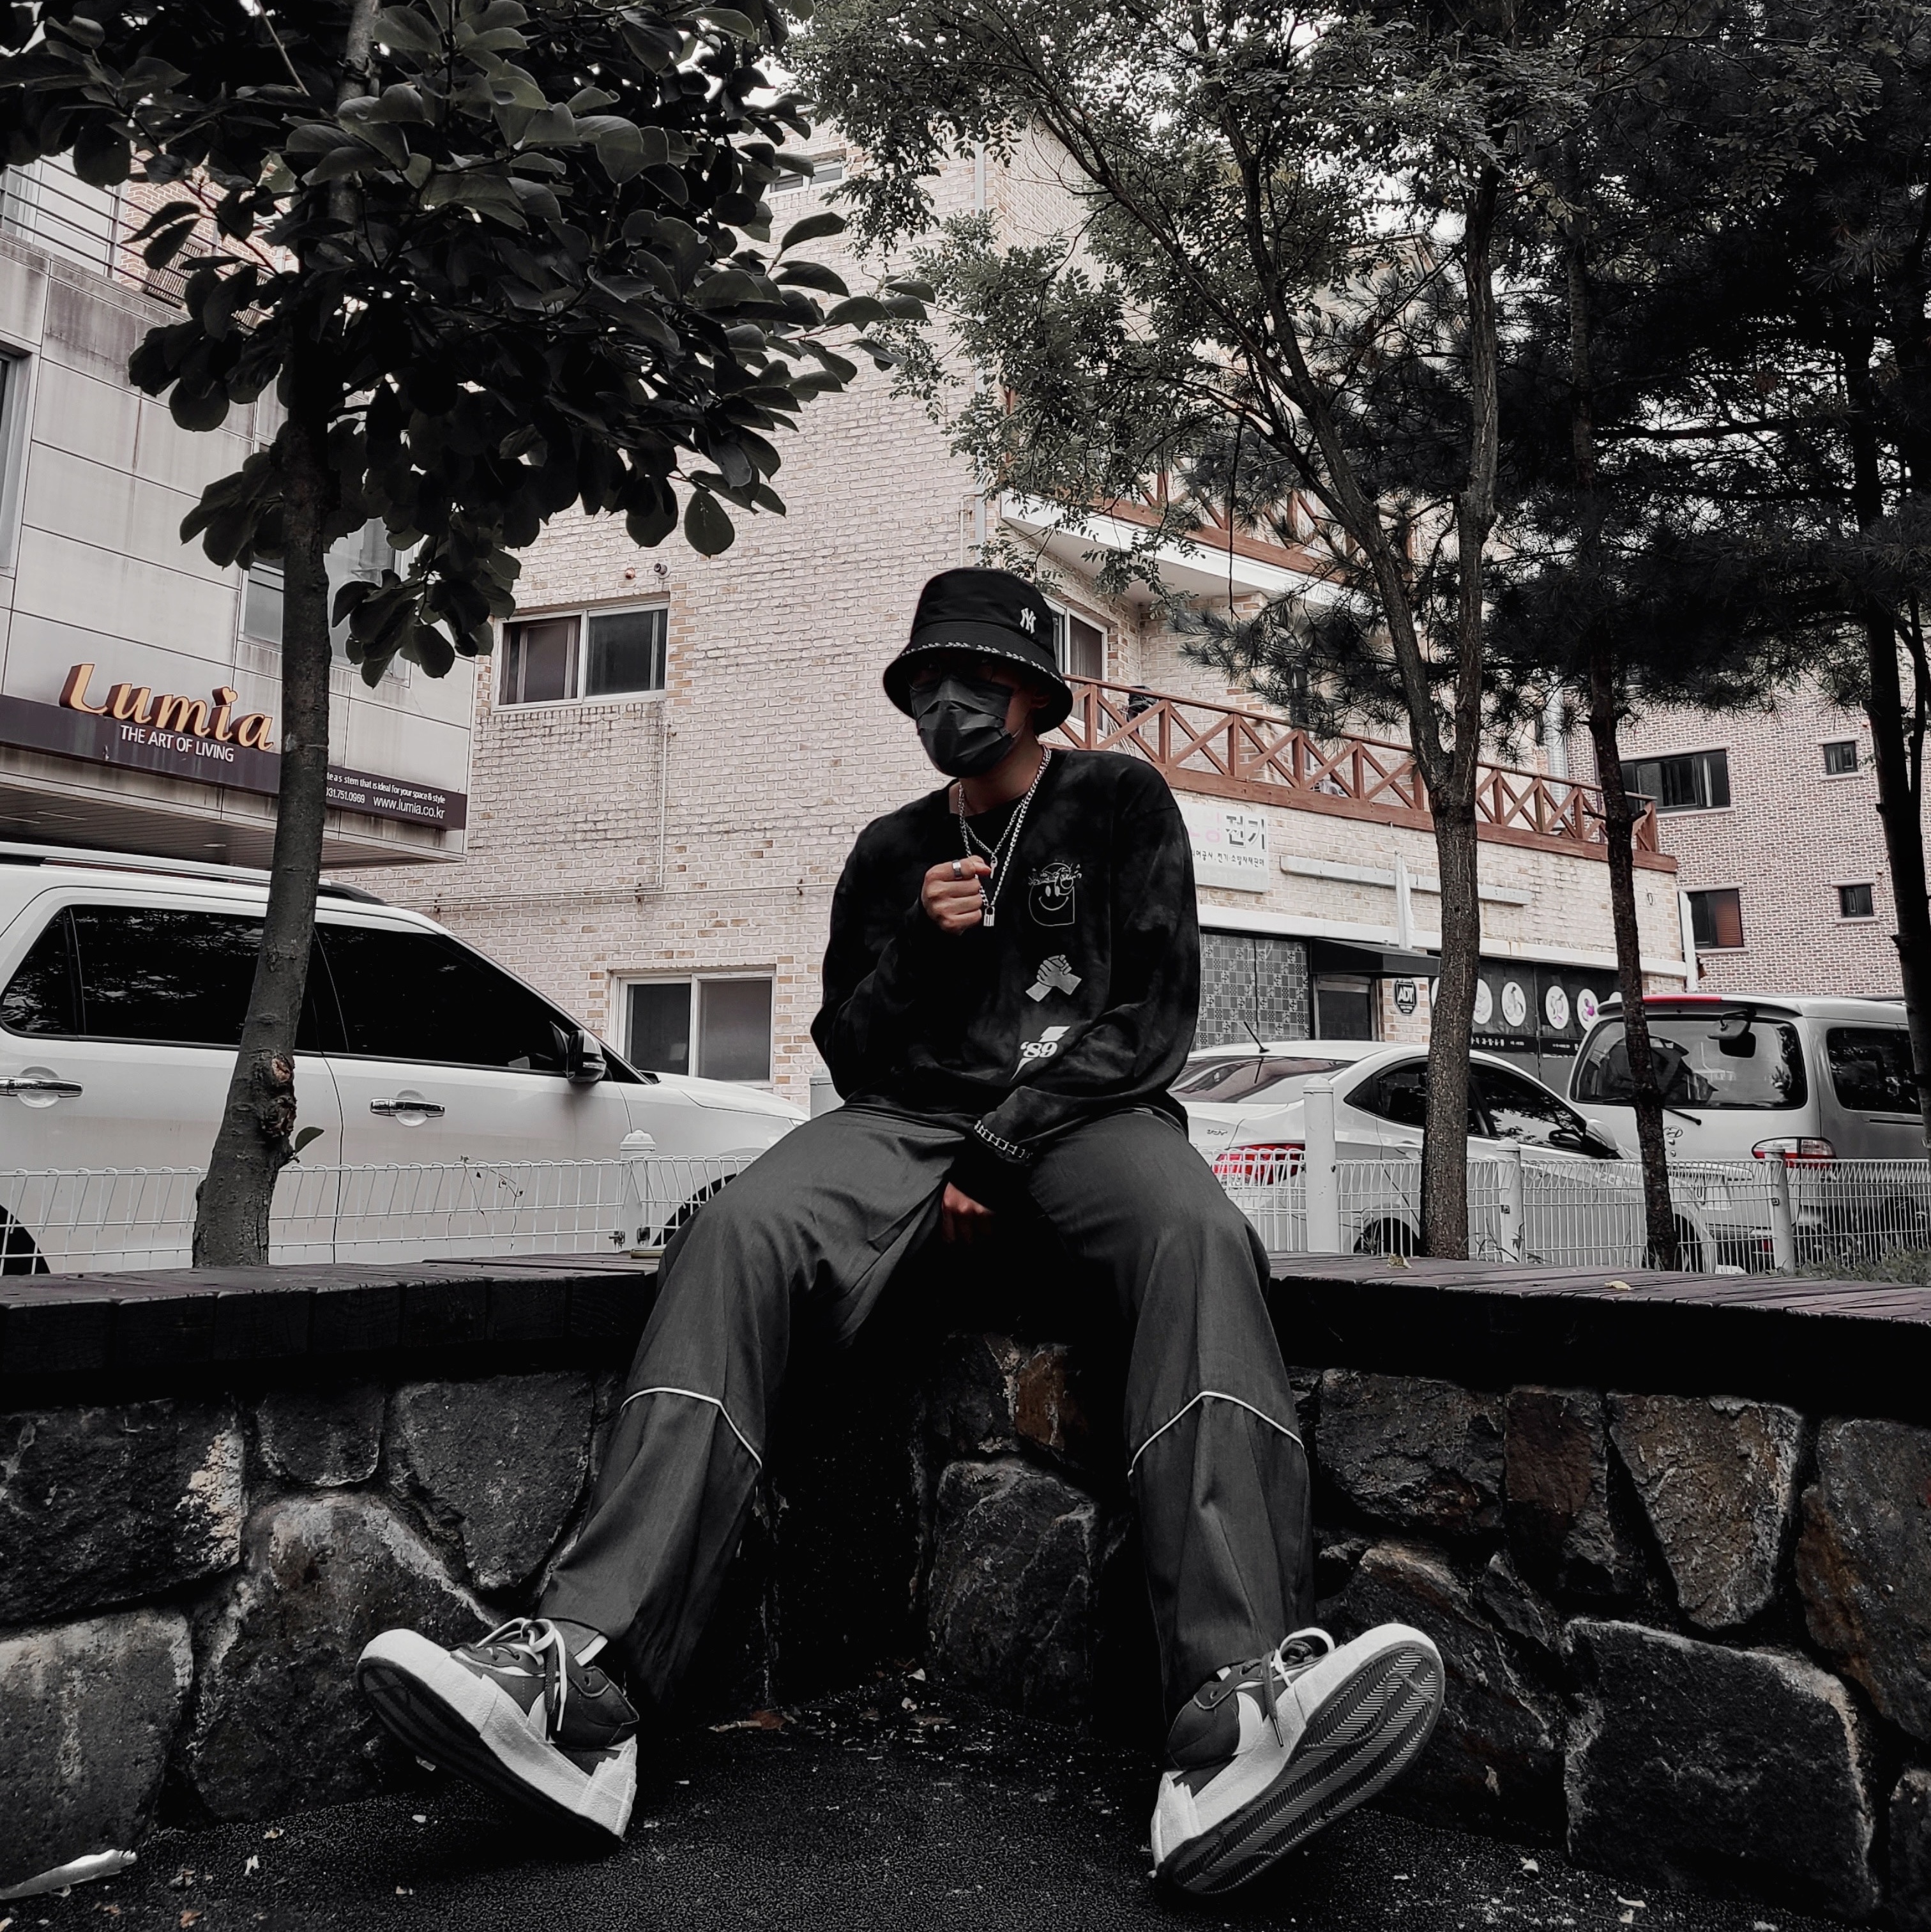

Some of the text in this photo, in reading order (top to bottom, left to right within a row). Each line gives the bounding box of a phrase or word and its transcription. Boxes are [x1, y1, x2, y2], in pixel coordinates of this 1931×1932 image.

[1020, 607, 1036, 634] NY
[60, 664, 274, 750] Lumia
[120, 724, 234, 763] THE ART OF LIVING
[360, 779, 372, 789] that
[377, 782, 391, 793] ideal
[391, 784, 400, 795] for
[400, 788, 413, 796] your
[413, 791, 427, 800] space
[427, 792, 432, 801] &
[432, 795, 446, 804] style
[373, 796, 445, 819] www.lumia.co.kr
[1398, 985, 1414, 1003] ADT
